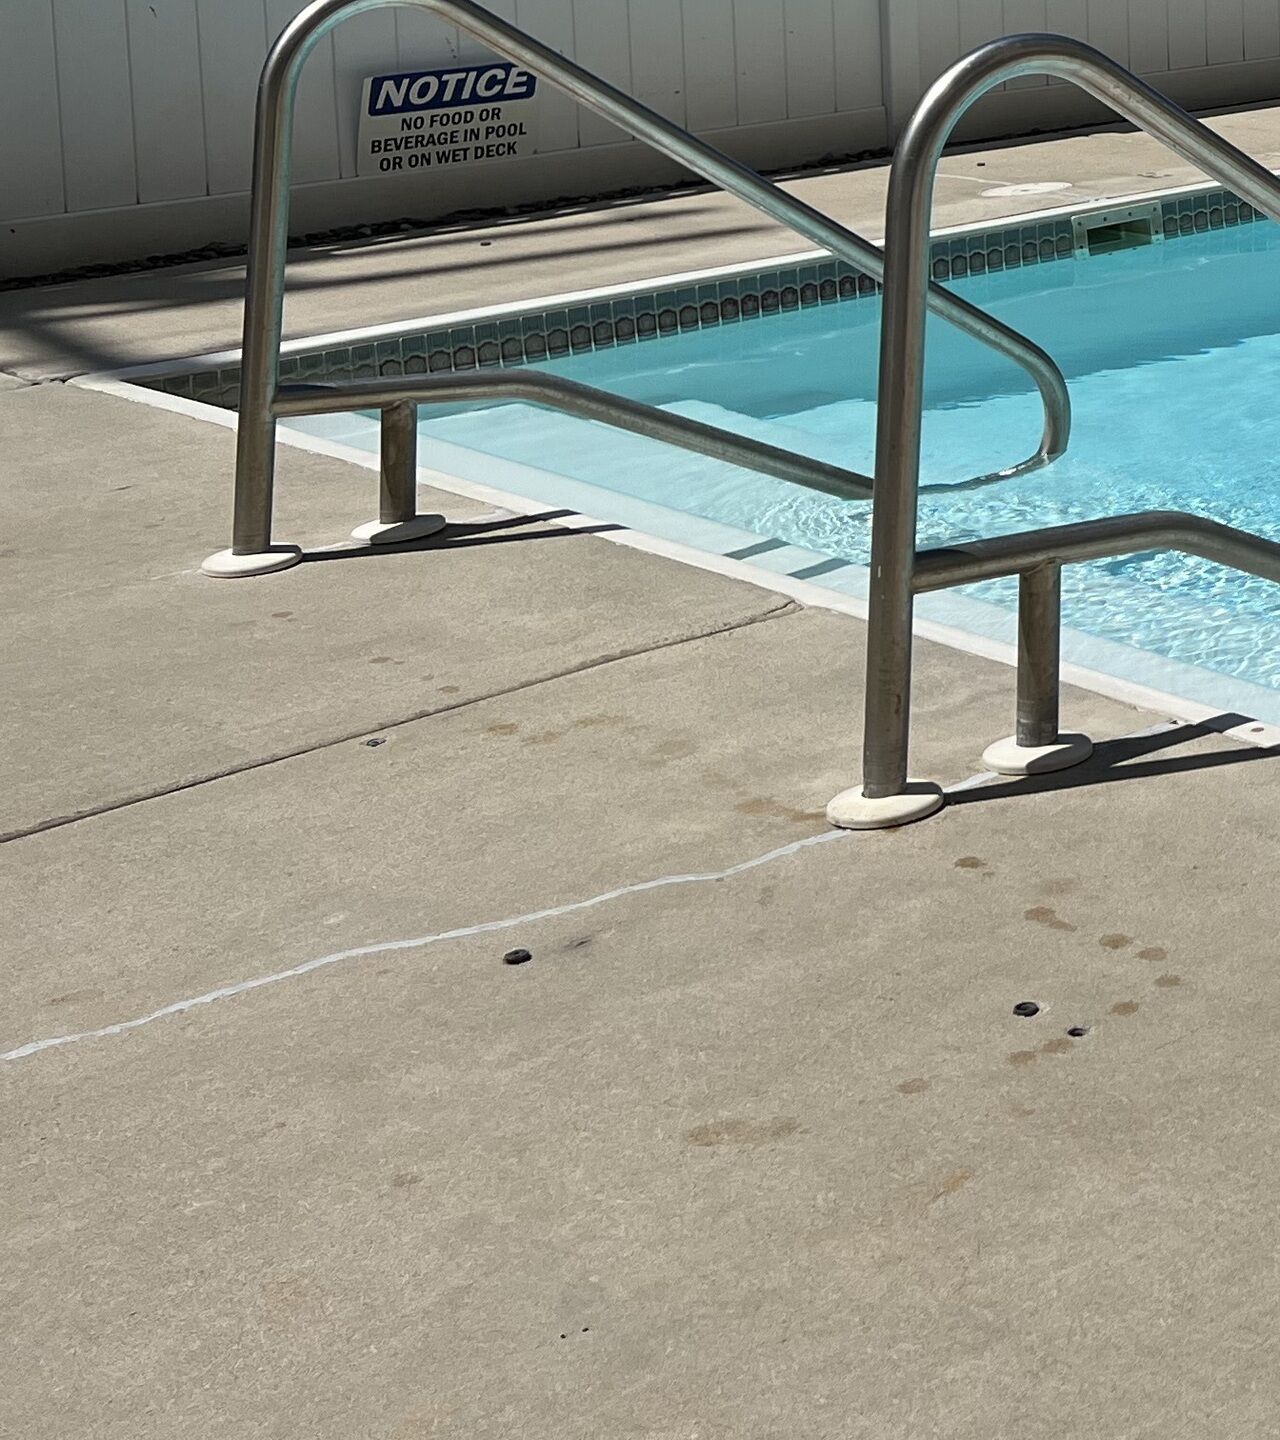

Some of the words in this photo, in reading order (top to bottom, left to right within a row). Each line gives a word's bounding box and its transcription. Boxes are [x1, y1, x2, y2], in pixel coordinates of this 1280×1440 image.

[375, 68, 529, 109] NOTICE
[401, 116, 424, 131] NO
[429, 111, 474, 128] FOOD
[479, 108, 501, 122] OR
[371, 129, 460, 154] BEVERAGE
[463, 127, 480, 142] IN
[485, 122, 527, 139] POOL
[379, 157, 403, 172] OR
[407, 152, 431, 168] ON
[435, 147, 470, 164] WET
[474, 141, 517, 161] DECK
